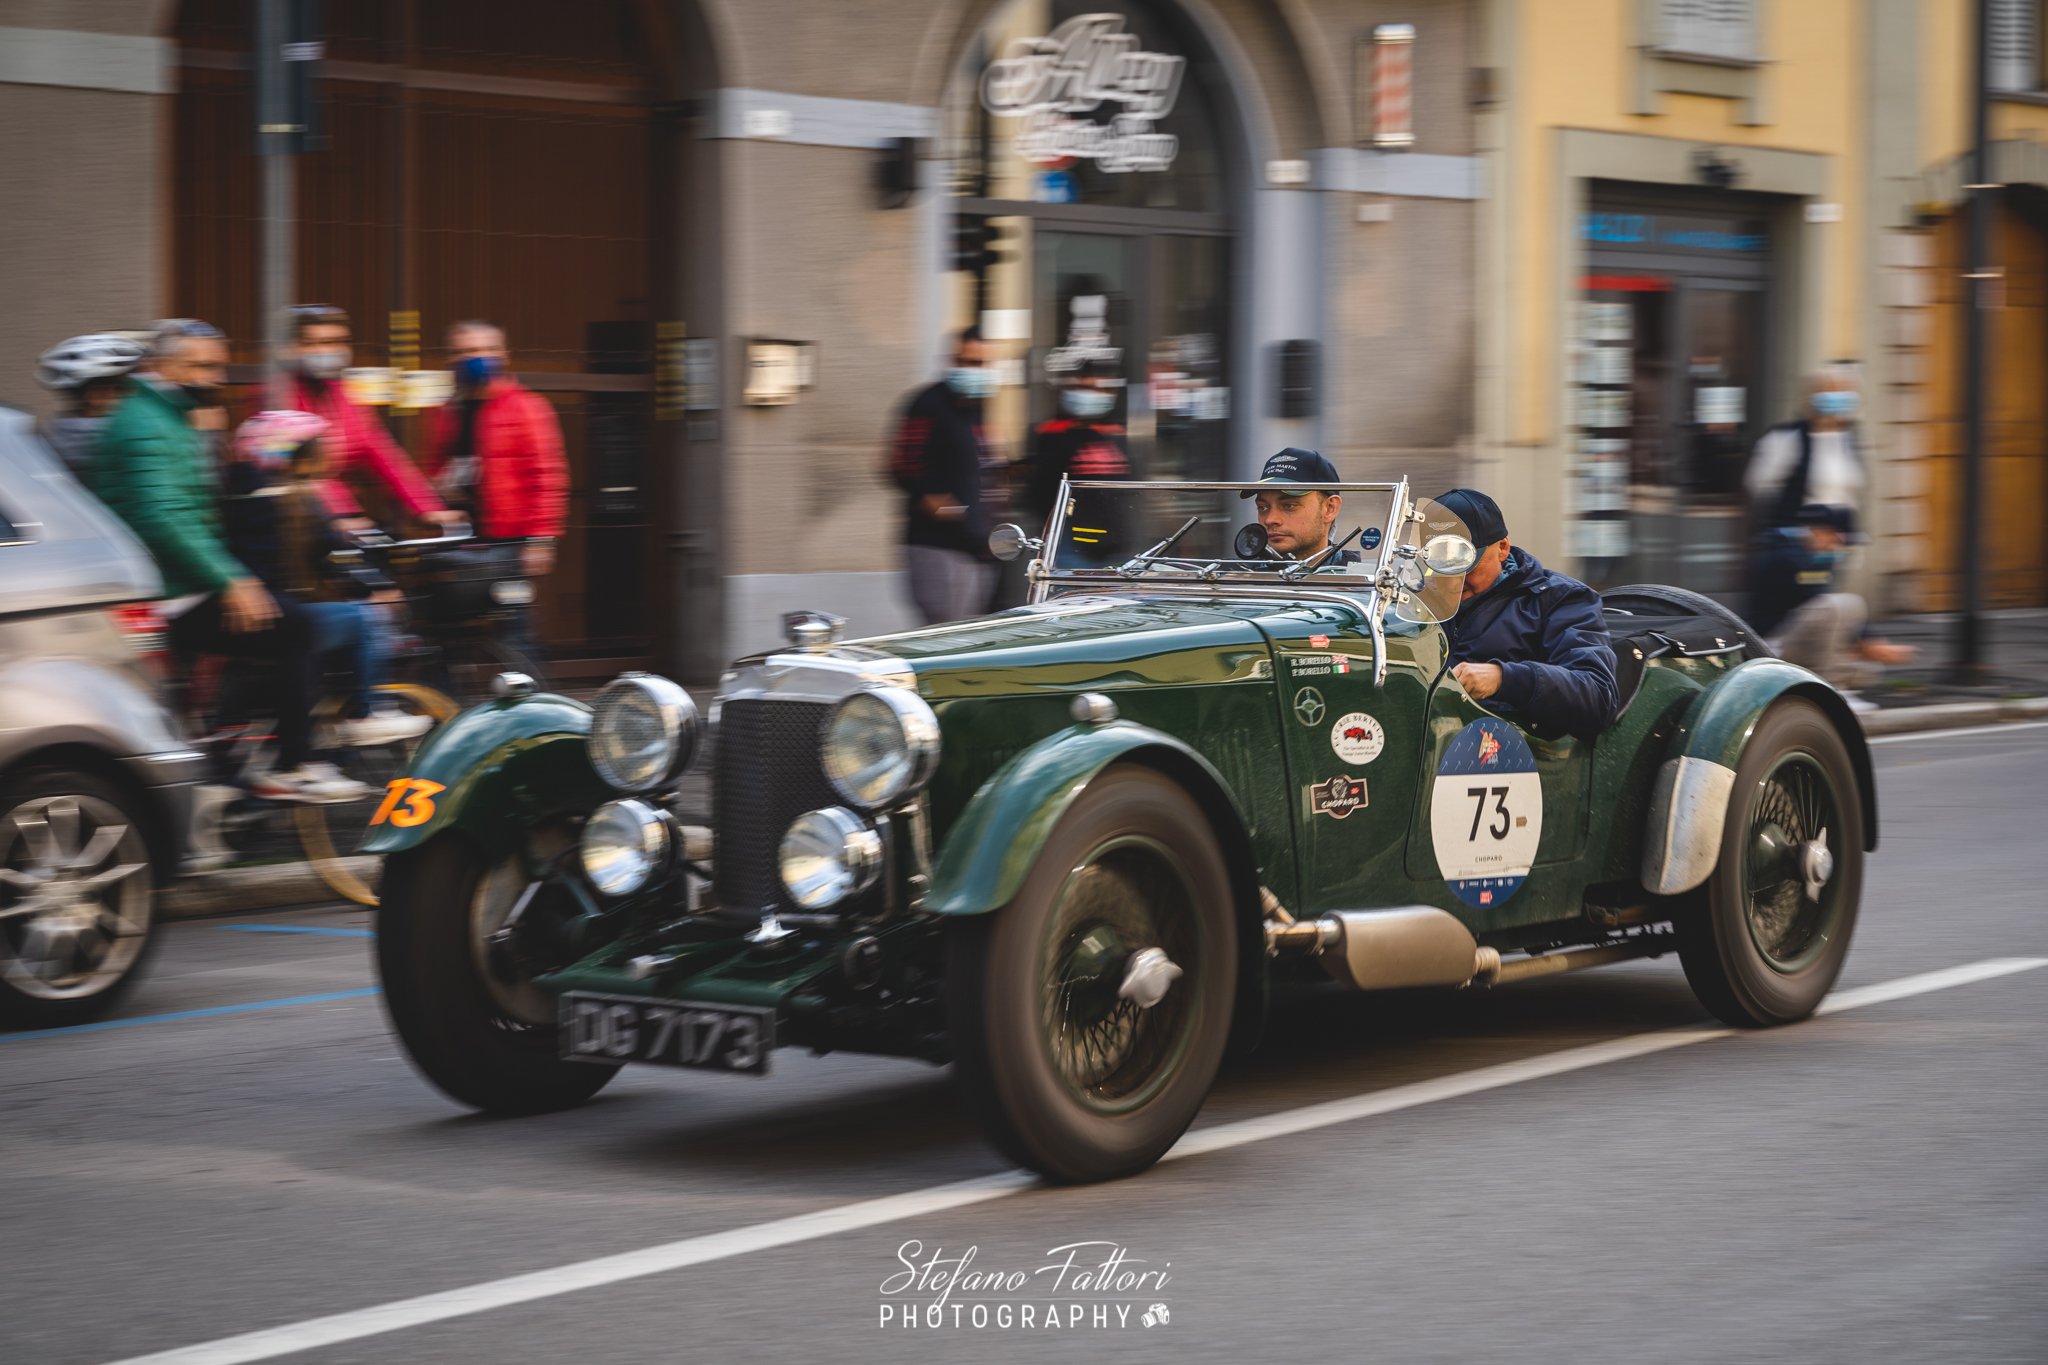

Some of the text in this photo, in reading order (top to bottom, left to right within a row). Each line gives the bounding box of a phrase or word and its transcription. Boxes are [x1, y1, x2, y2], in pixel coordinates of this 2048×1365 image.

[1276, 463, 1297, 471] MARTIN
[1467, 786, 1510, 842] 73
[574, 1002, 761, 1070] DG 7173
